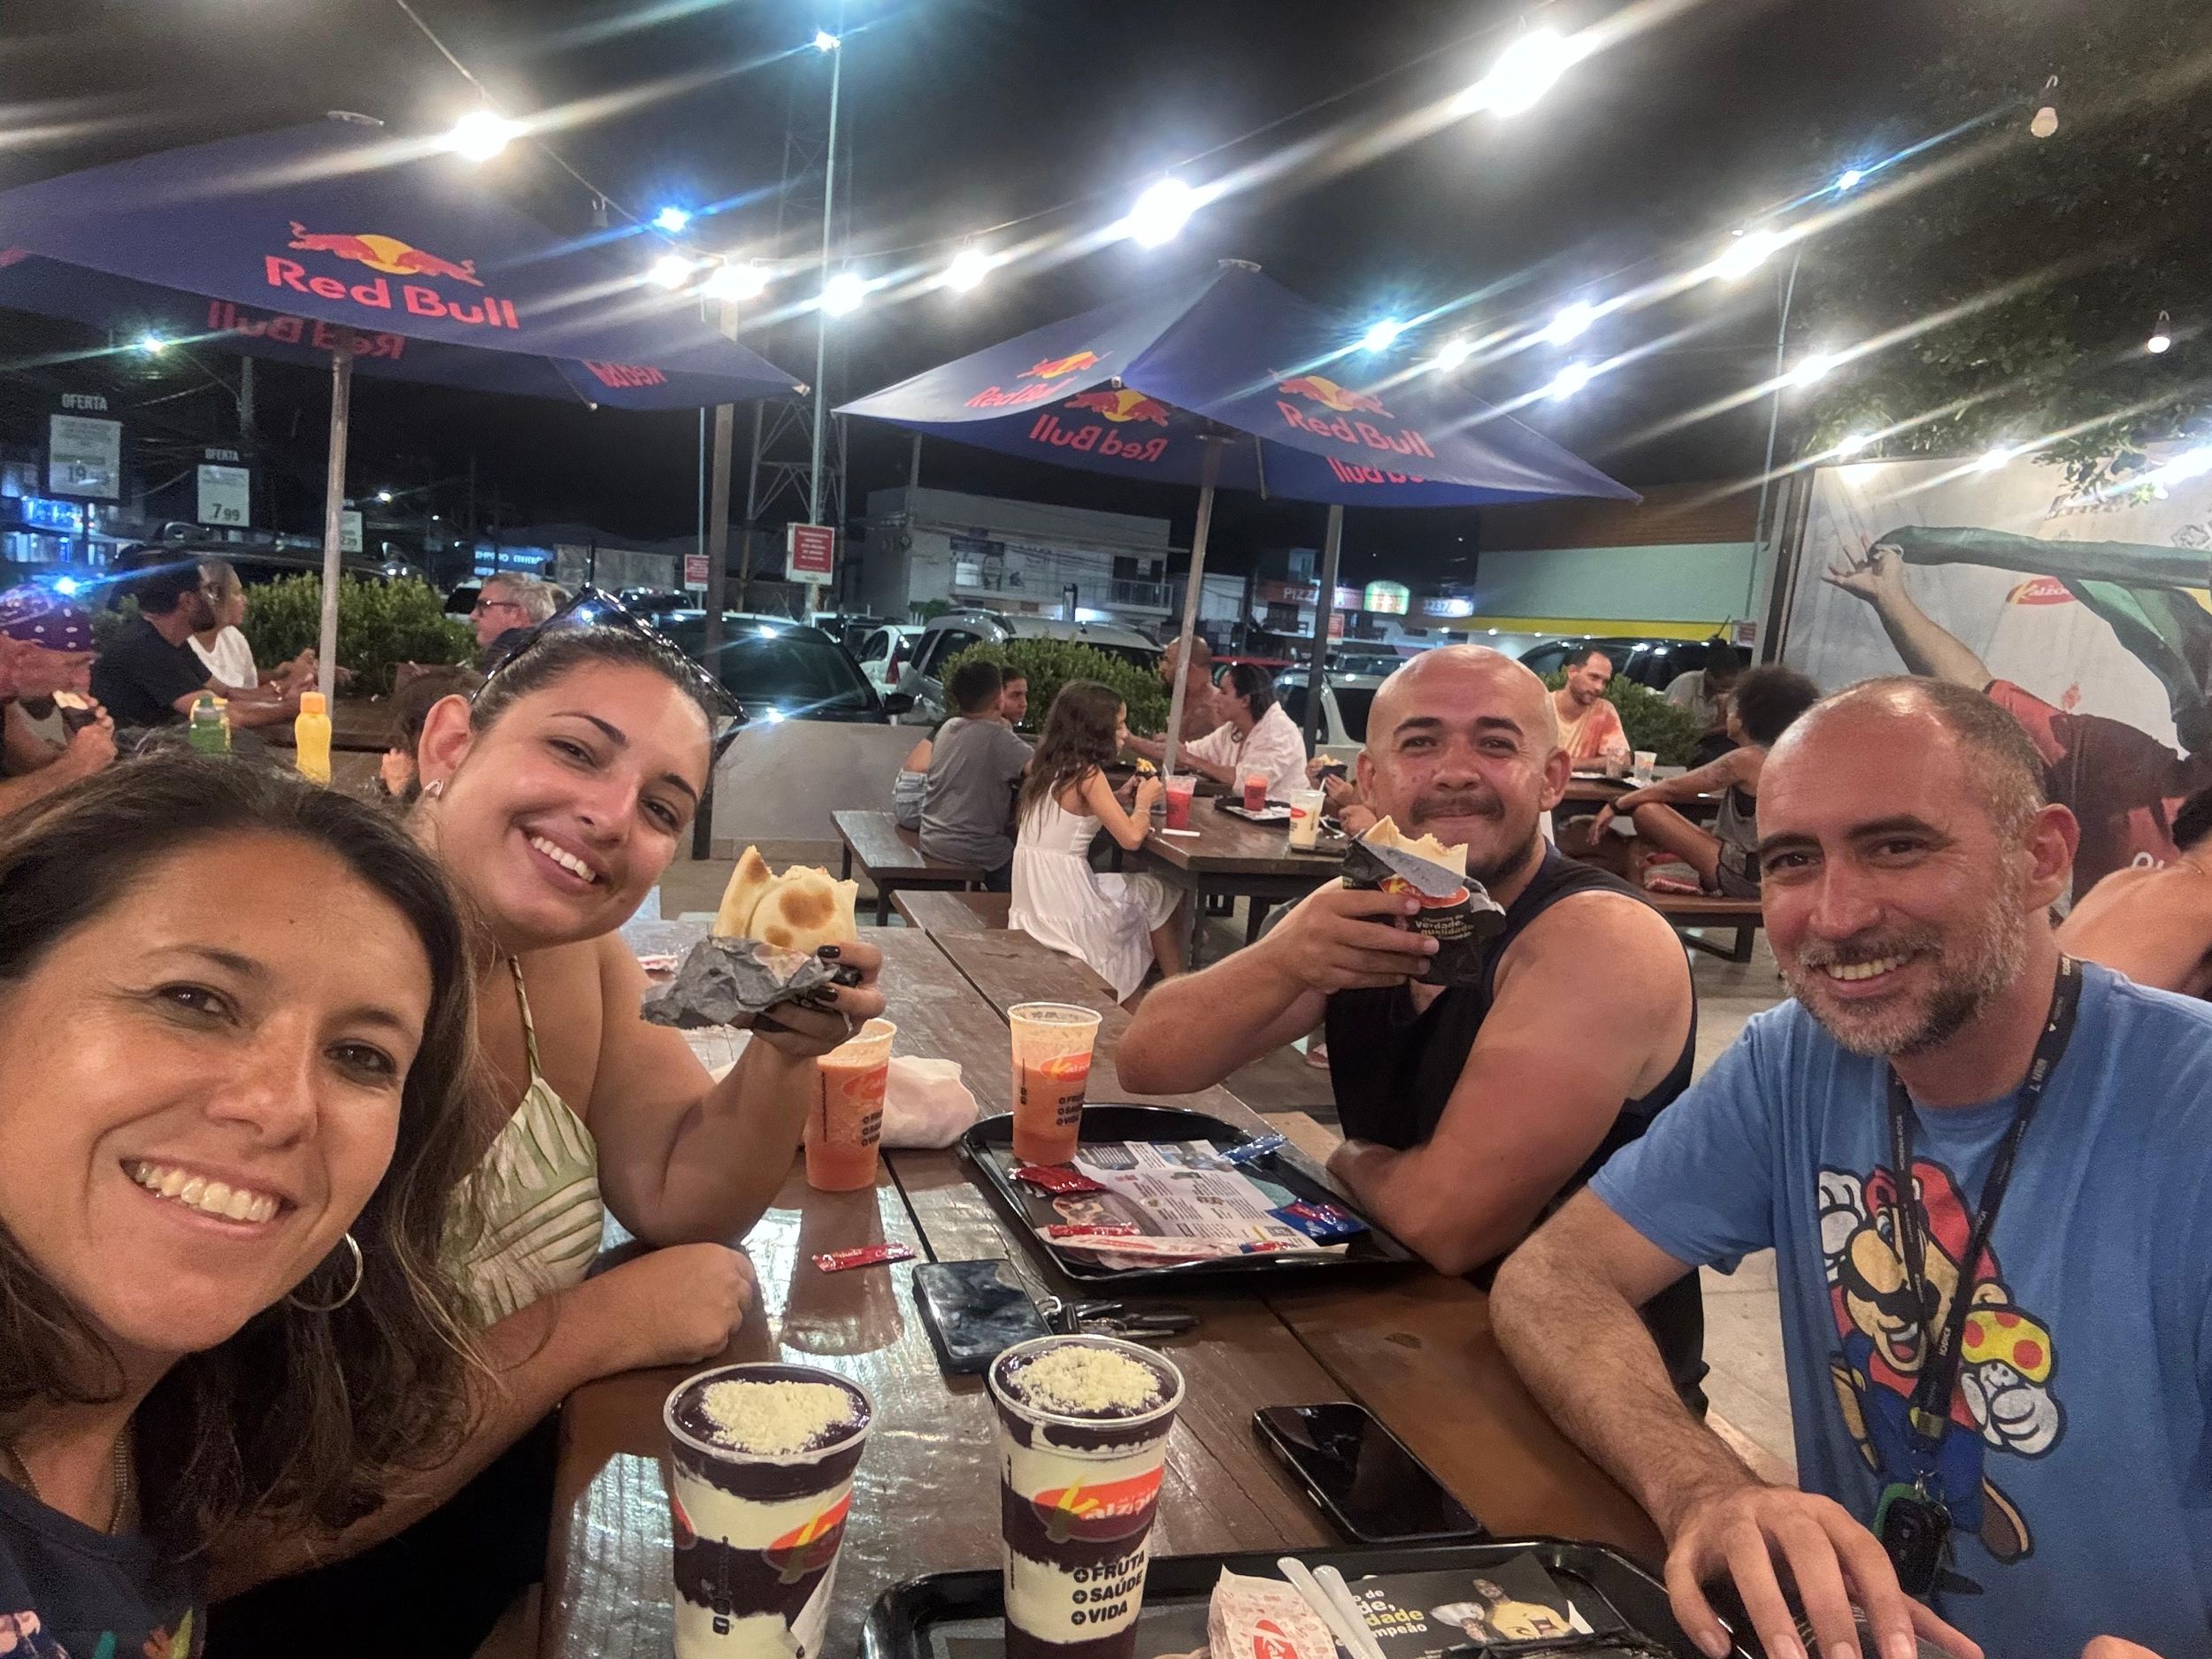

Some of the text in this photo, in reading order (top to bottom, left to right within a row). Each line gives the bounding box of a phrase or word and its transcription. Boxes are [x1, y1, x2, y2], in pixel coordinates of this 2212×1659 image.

[265, 255, 519, 330] Red Bull
[61, 393, 108, 411] OFERTA
[1276, 400, 1436, 459] Red Bull
[1091, 1549, 1145, 1582] FRUTA
[1089, 1569, 1144, 1603] SAÚDE
[1364, 1589, 1385, 1600] de
[1088, 1600, 1128, 1624] VIDA
[1365, 1609, 1425, 1627] dade
[1371, 1622, 1428, 1638] mpeão
